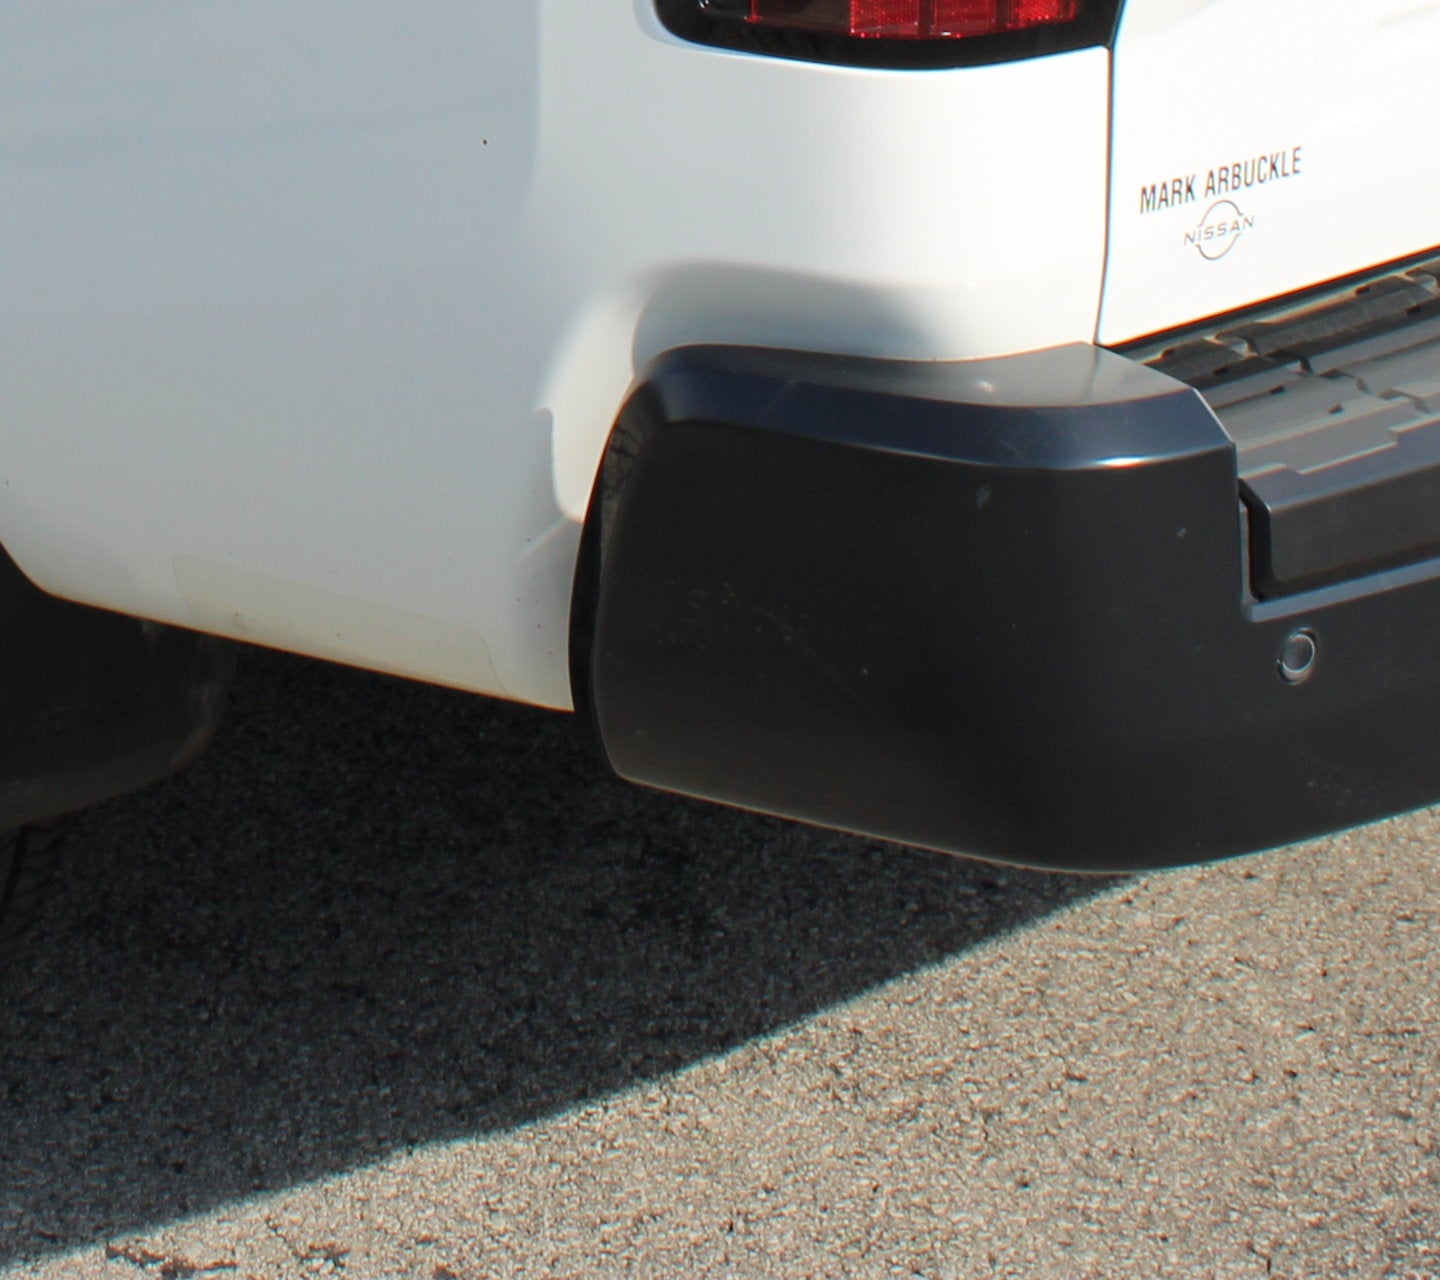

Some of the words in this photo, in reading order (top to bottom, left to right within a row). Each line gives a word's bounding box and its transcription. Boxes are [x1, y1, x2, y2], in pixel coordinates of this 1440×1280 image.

[1139, 173, 1196, 214] MARK
[1204, 145, 1302, 198] ARBUCKLE
[1183, 215, 1255, 246] NISSAN
